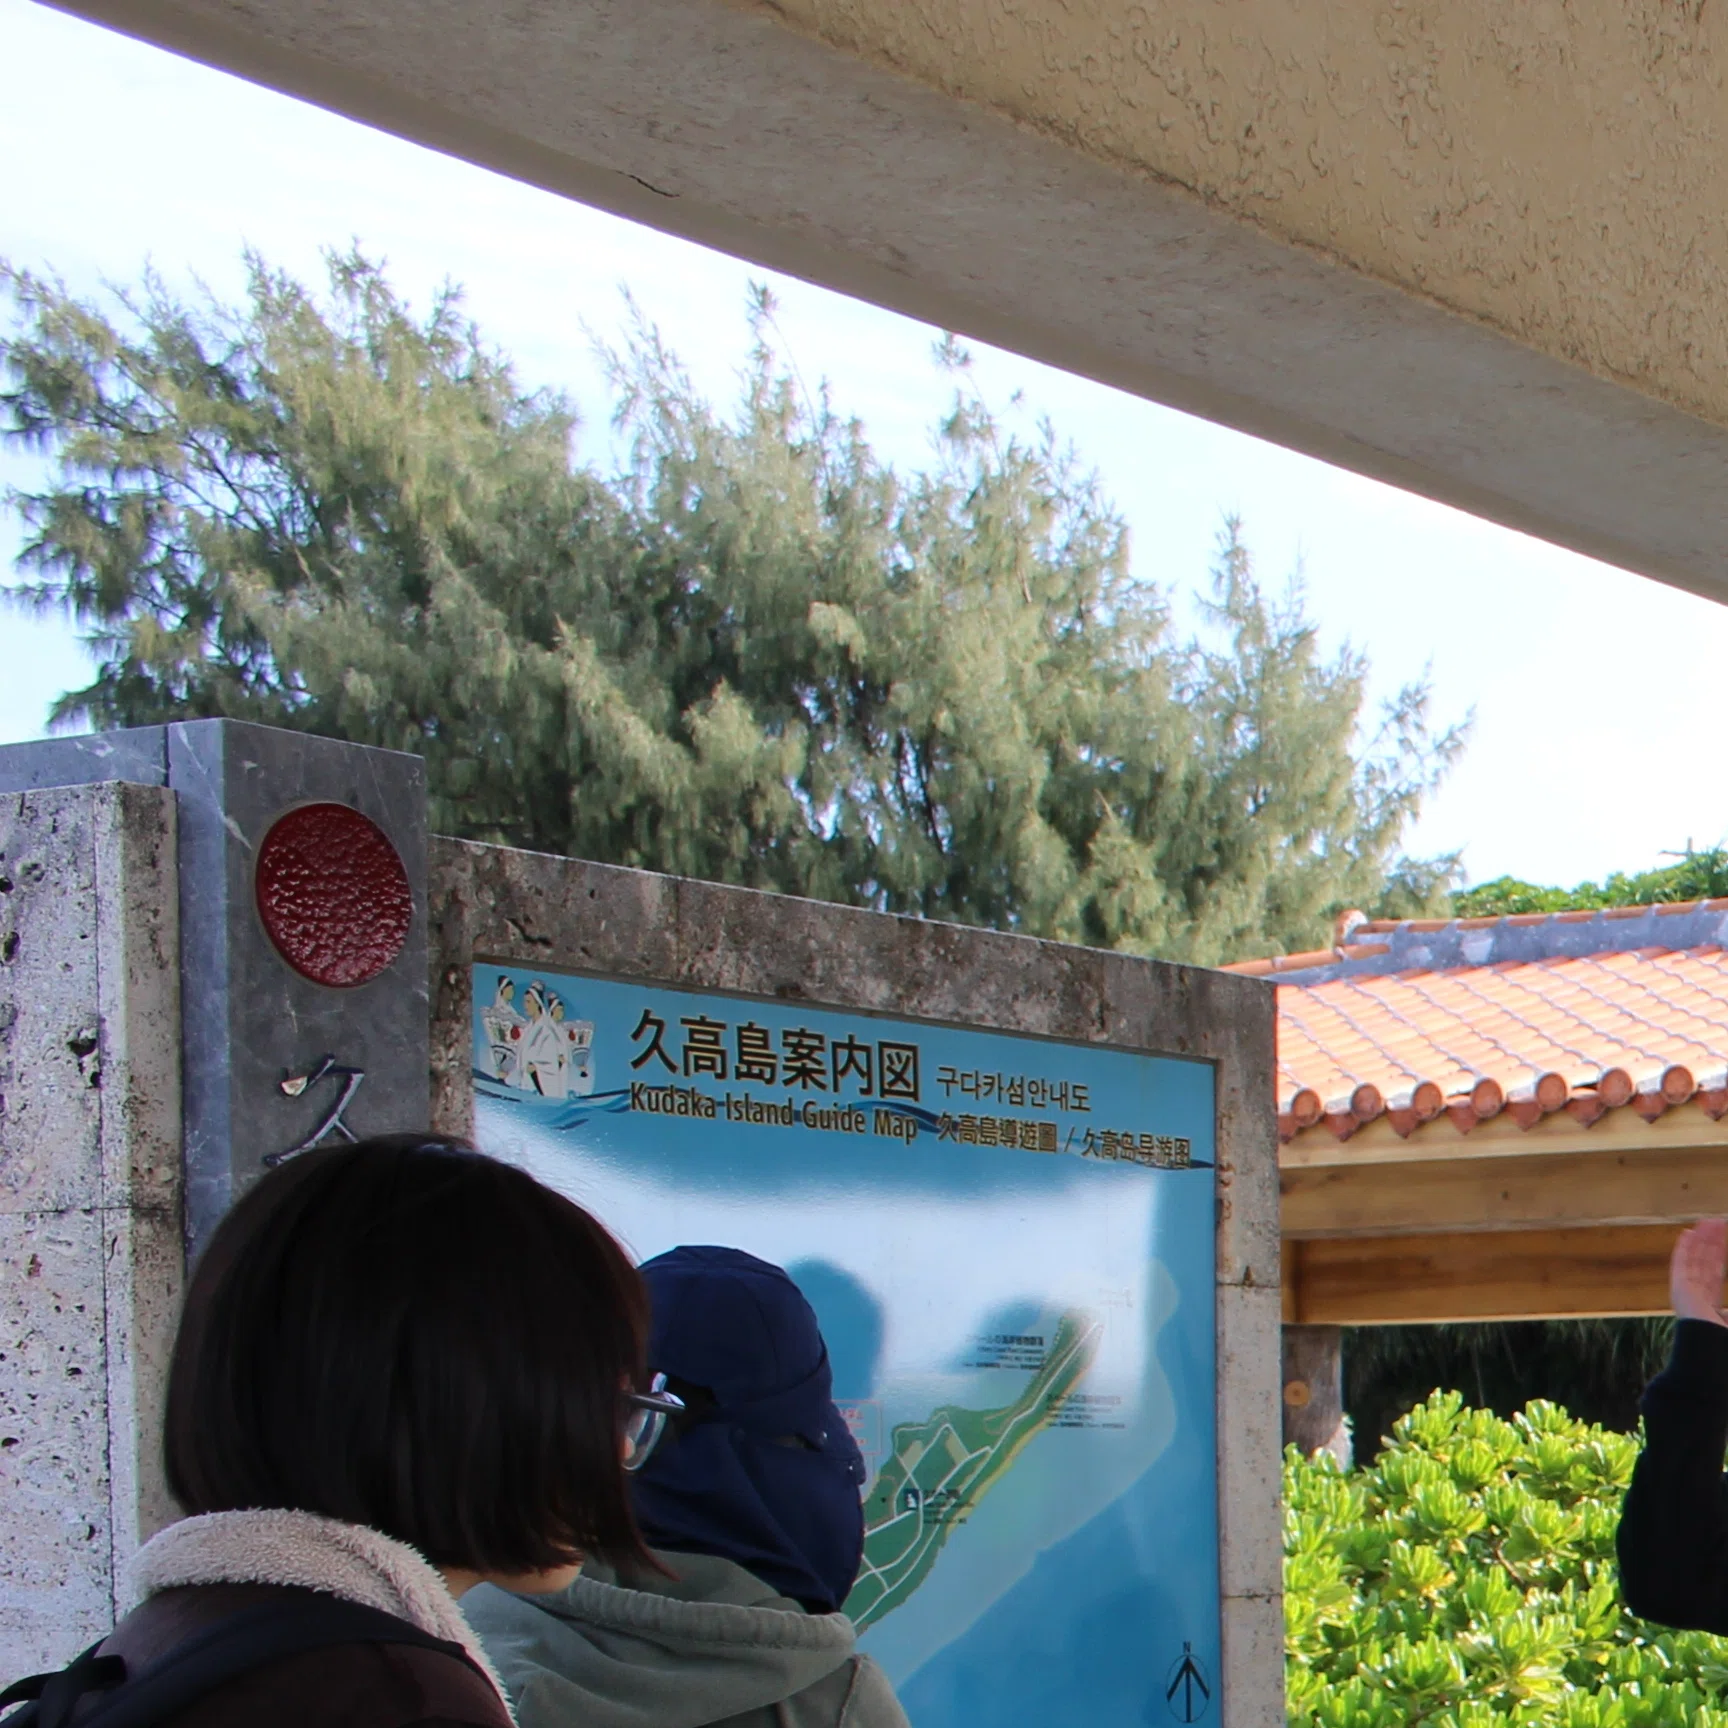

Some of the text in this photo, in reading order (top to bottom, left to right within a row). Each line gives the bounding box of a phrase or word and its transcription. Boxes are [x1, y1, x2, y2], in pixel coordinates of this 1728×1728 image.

[629, 1008, 920, 1101] 久高島案内図
[630, 1081, 918, 1145] Kudaka Island Guide Map
[936, 1066, 1092, 1112] 구다카섬안내도
[1183, 1641, 1191, 1653] N
